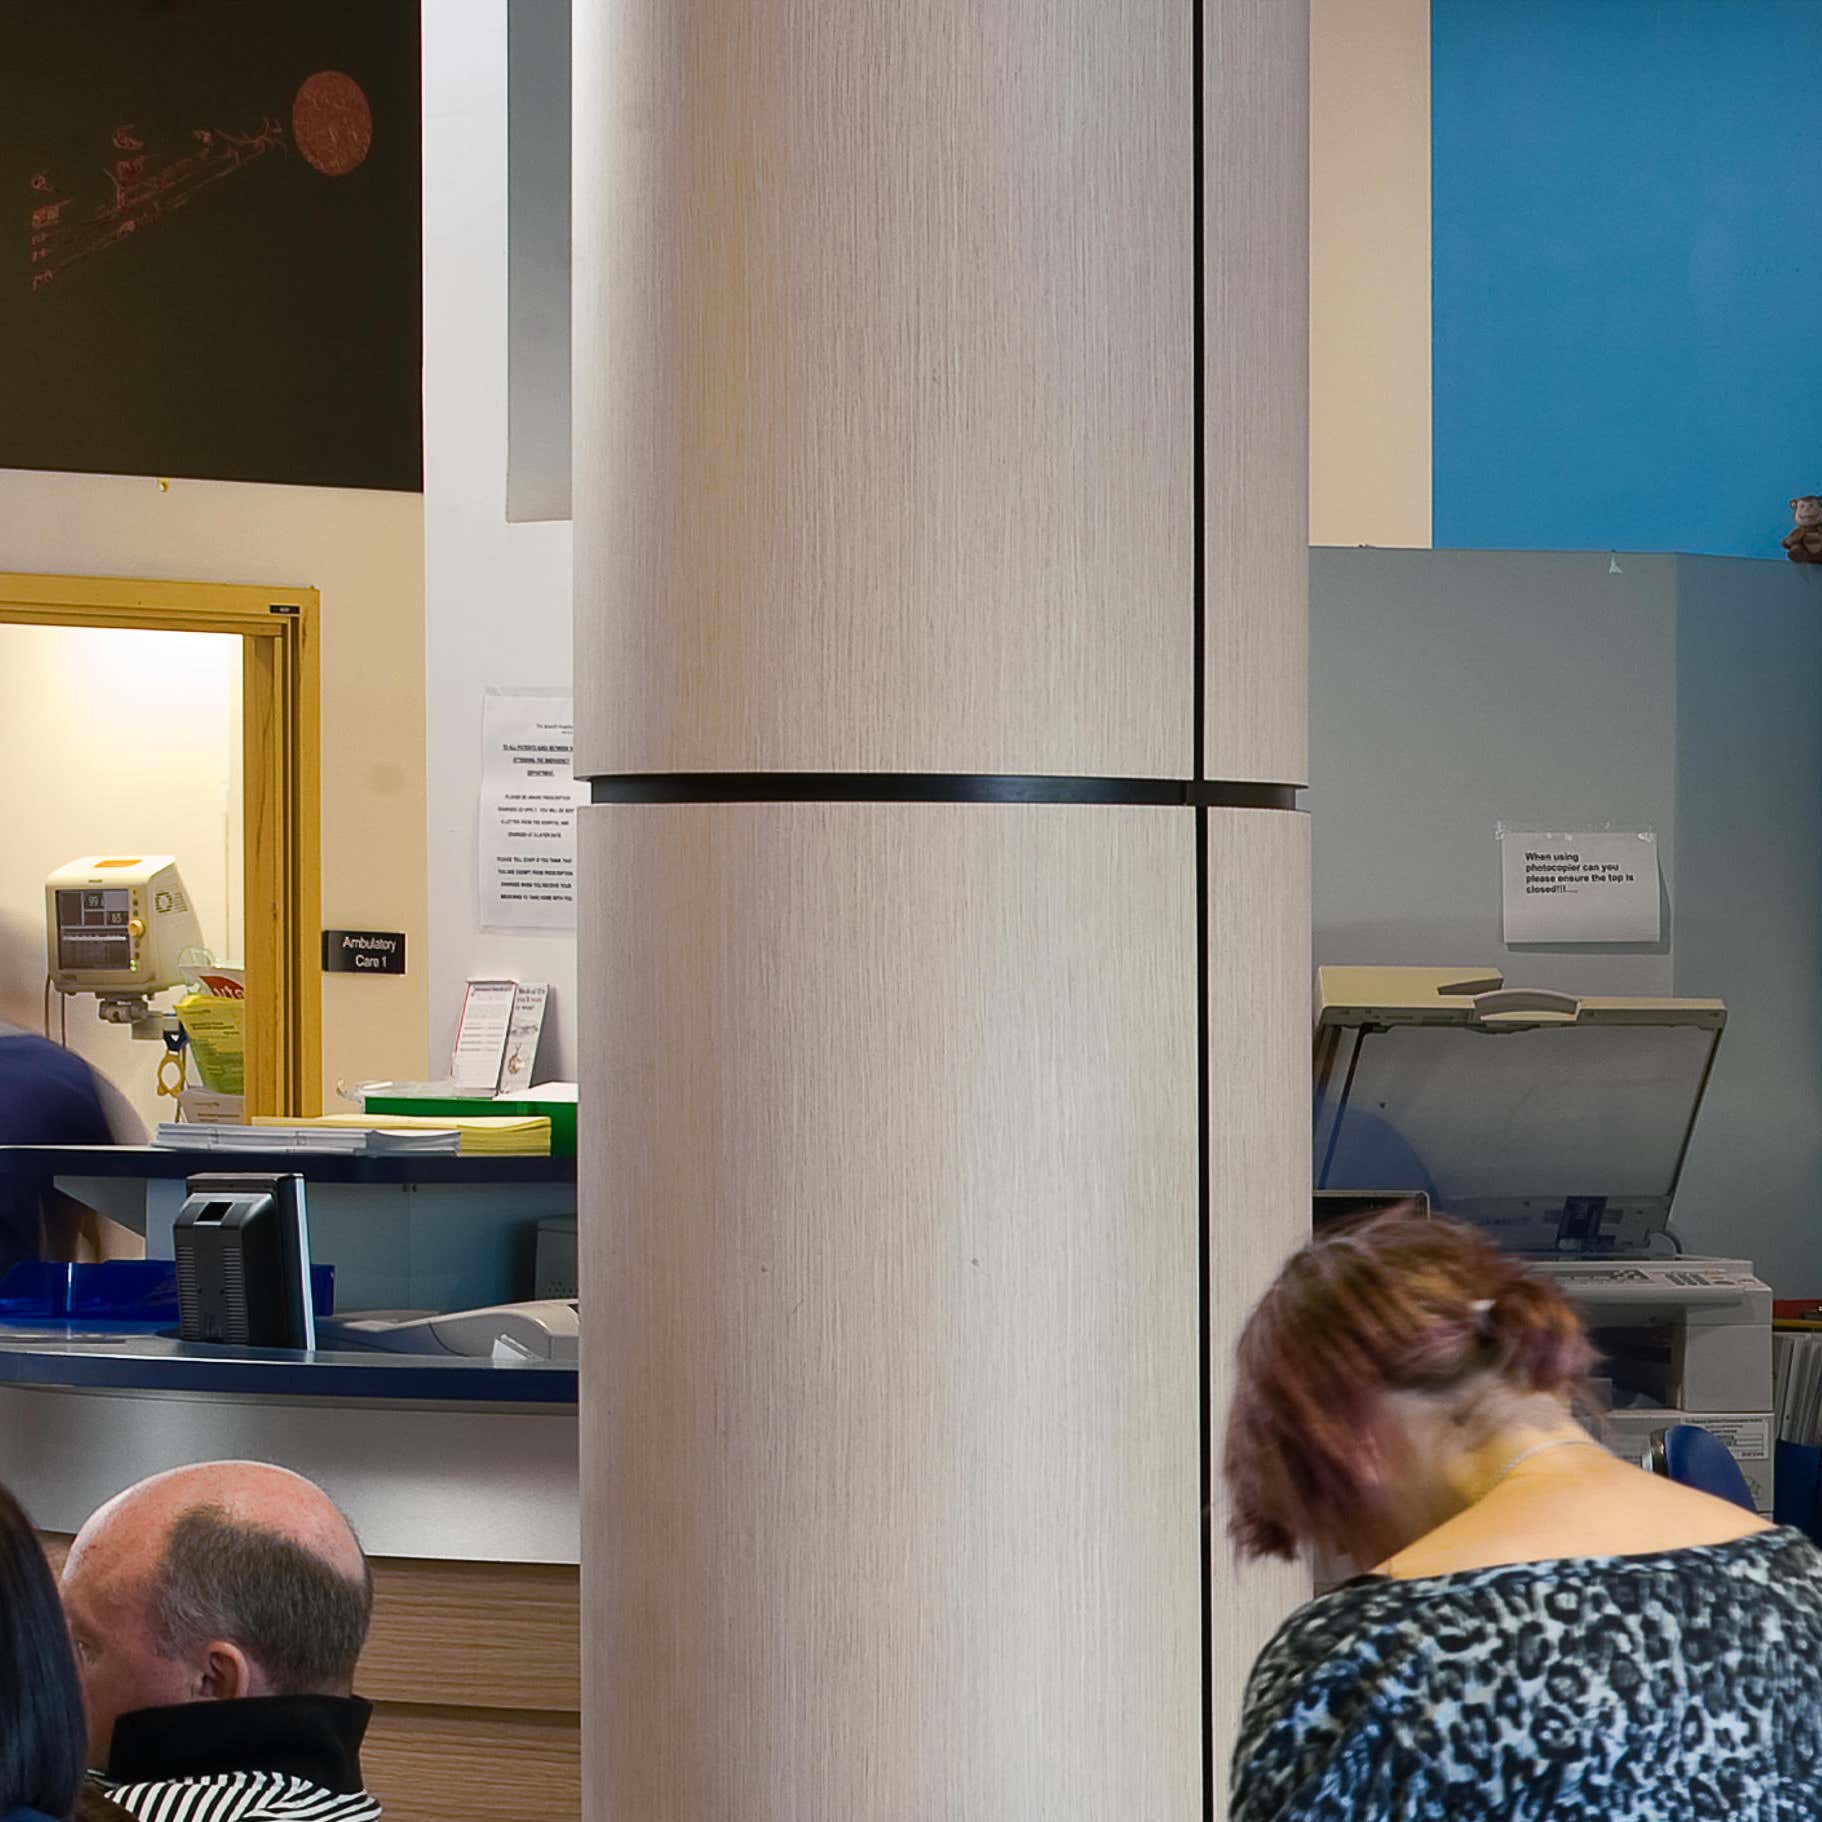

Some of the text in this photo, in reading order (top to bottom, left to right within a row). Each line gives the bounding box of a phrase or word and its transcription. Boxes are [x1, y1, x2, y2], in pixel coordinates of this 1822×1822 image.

[1553, 852, 1579, 862] using
[1526, 864, 1580, 873] photocopier
[1601, 864, 1619, 873] you
[1526, 875, 1555, 884] please
[1608, 874, 1624, 883] top
[342, 936, 396, 953] Ambulatory
[356, 955, 386, 968] Care 1
